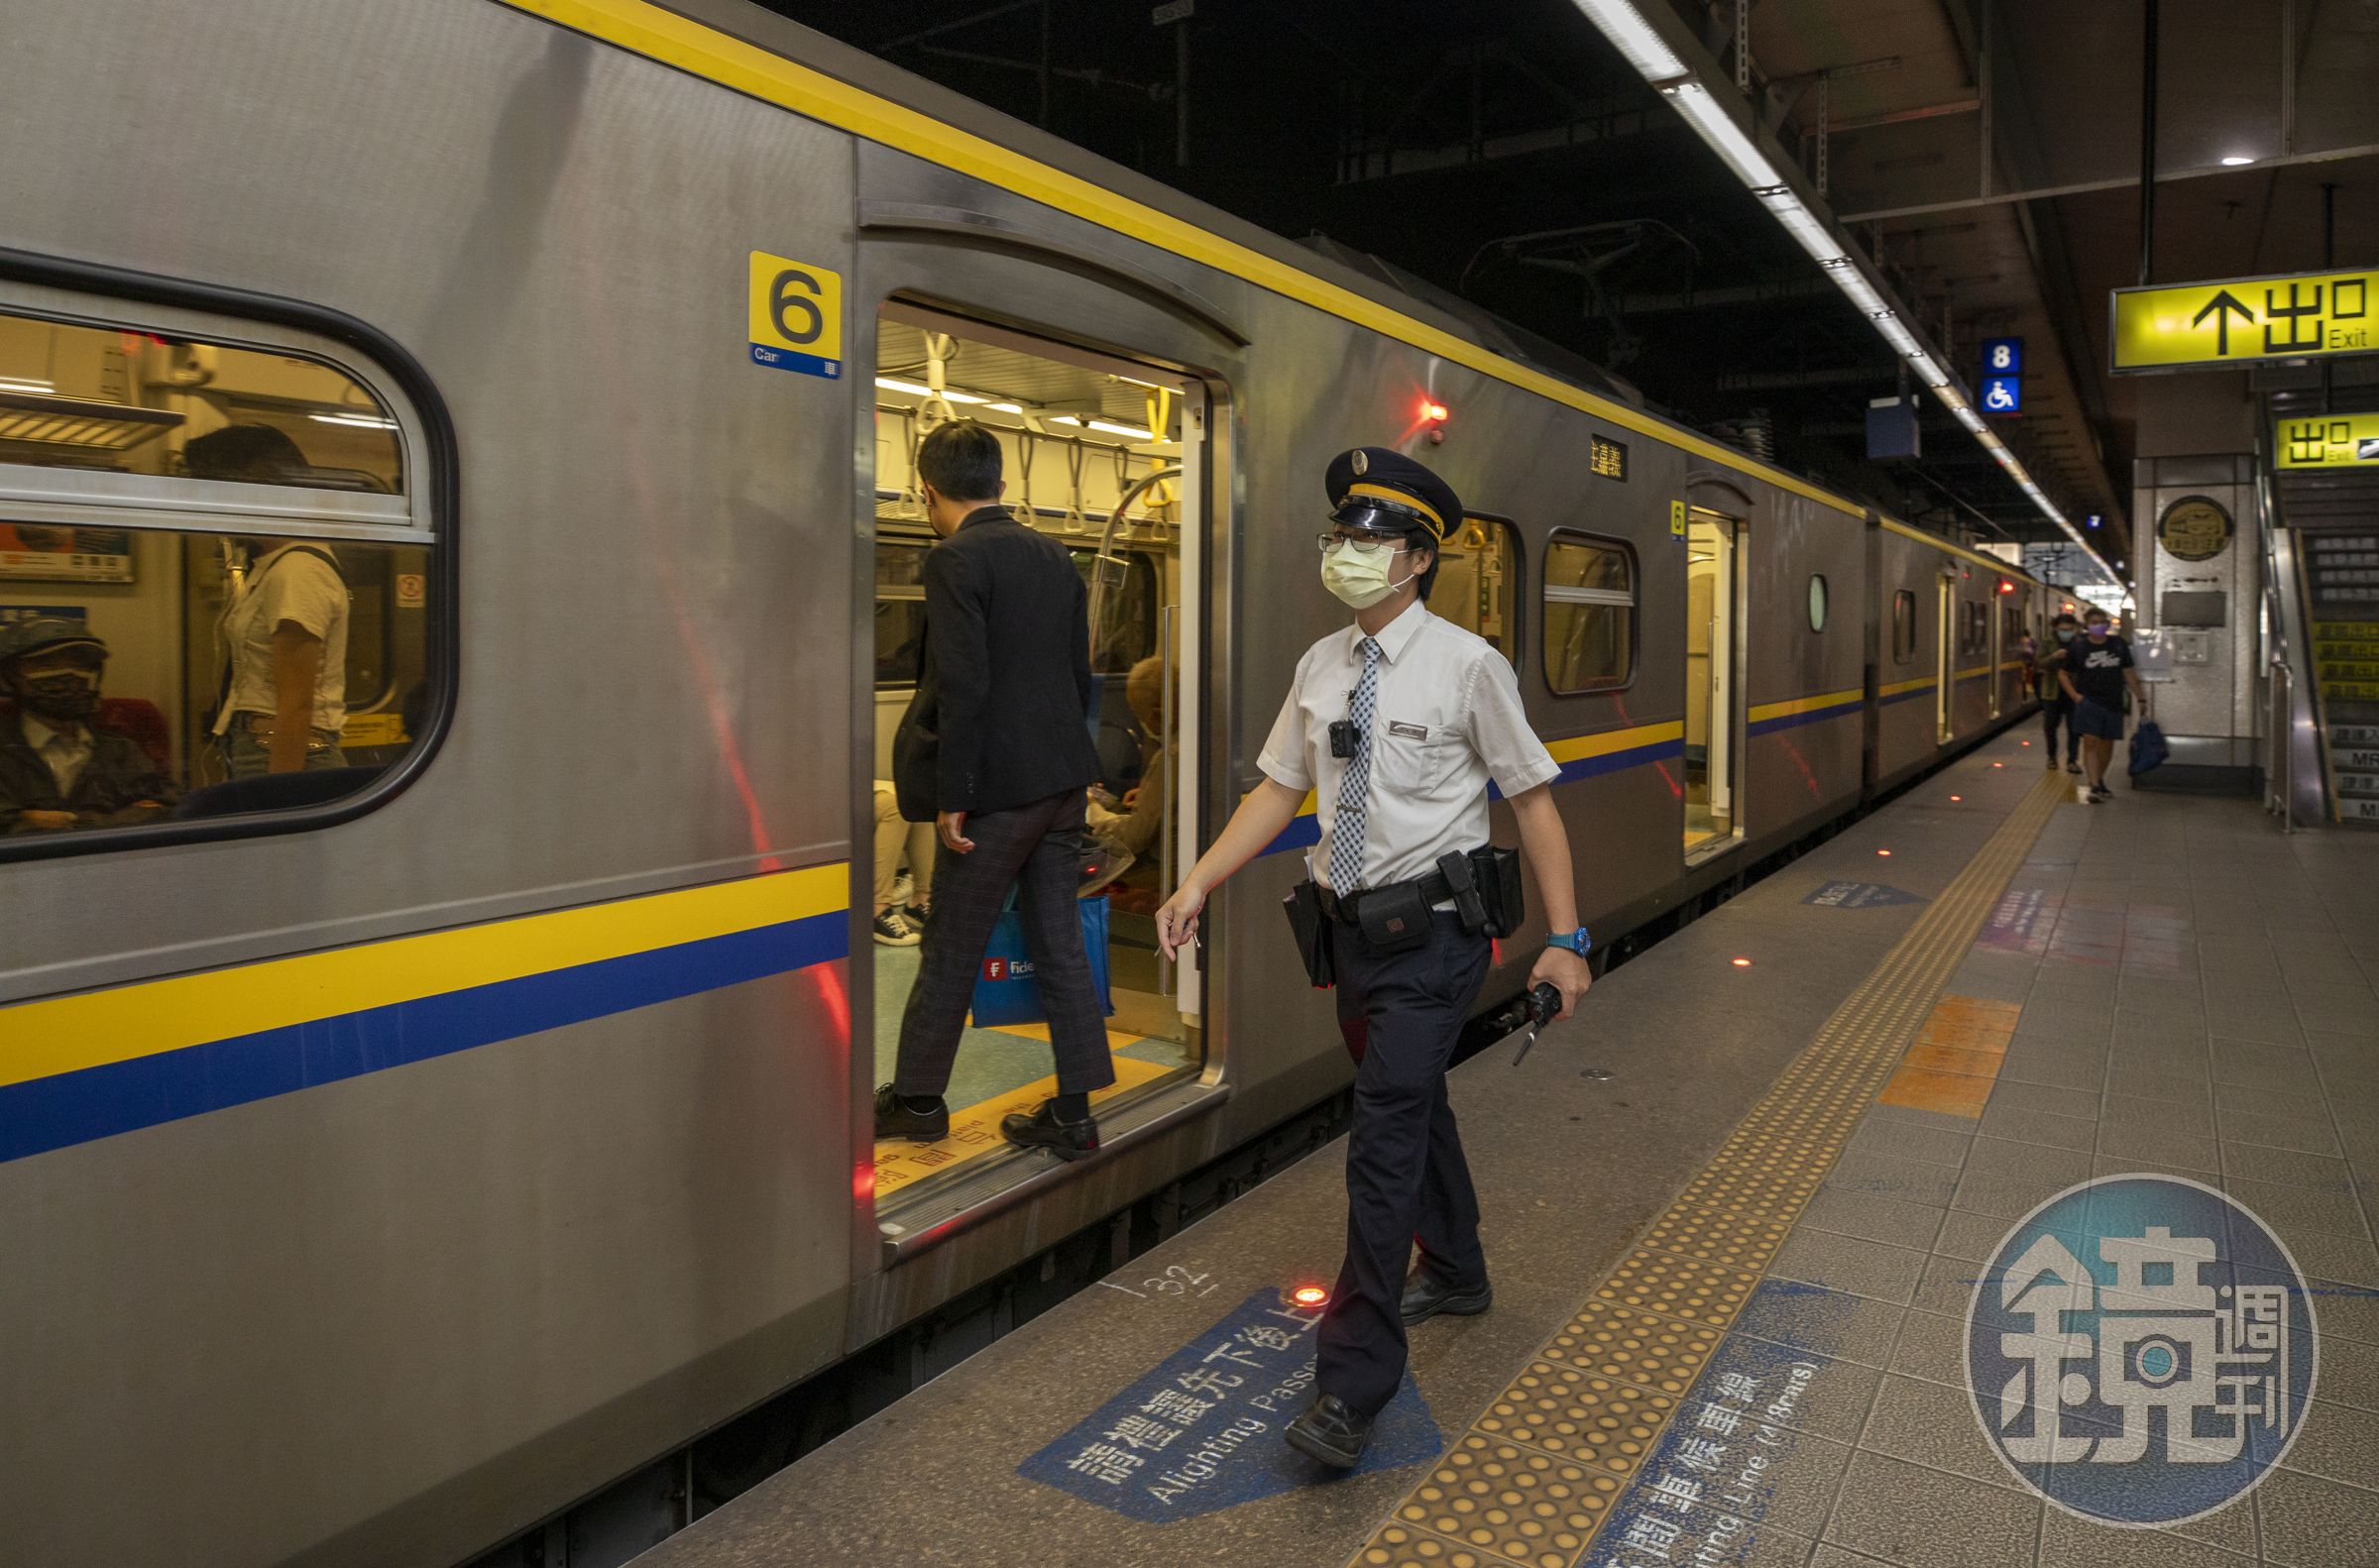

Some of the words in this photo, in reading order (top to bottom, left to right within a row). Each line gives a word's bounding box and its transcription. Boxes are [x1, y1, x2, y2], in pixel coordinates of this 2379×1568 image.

[769, 269, 823, 345] 6
[2264, 279, 2366, 354] 出口
[754, 347, 778, 363] Car
[1992, 345, 2011, 369] 8
[2329, 328, 2367, 349] Exit
[2290, 421, 2349, 463] 出口
[1675, 505, 1682, 530] 6
[1010, 960, 1036, 973] Fide
[1146, 1416, 1269, 1506] Alighting
[1249, 1352, 1318, 1412] Passe
[1608, 1372, 1761, 1568] 間車候車線
[1723, 1455, 1768, 1506] Line
